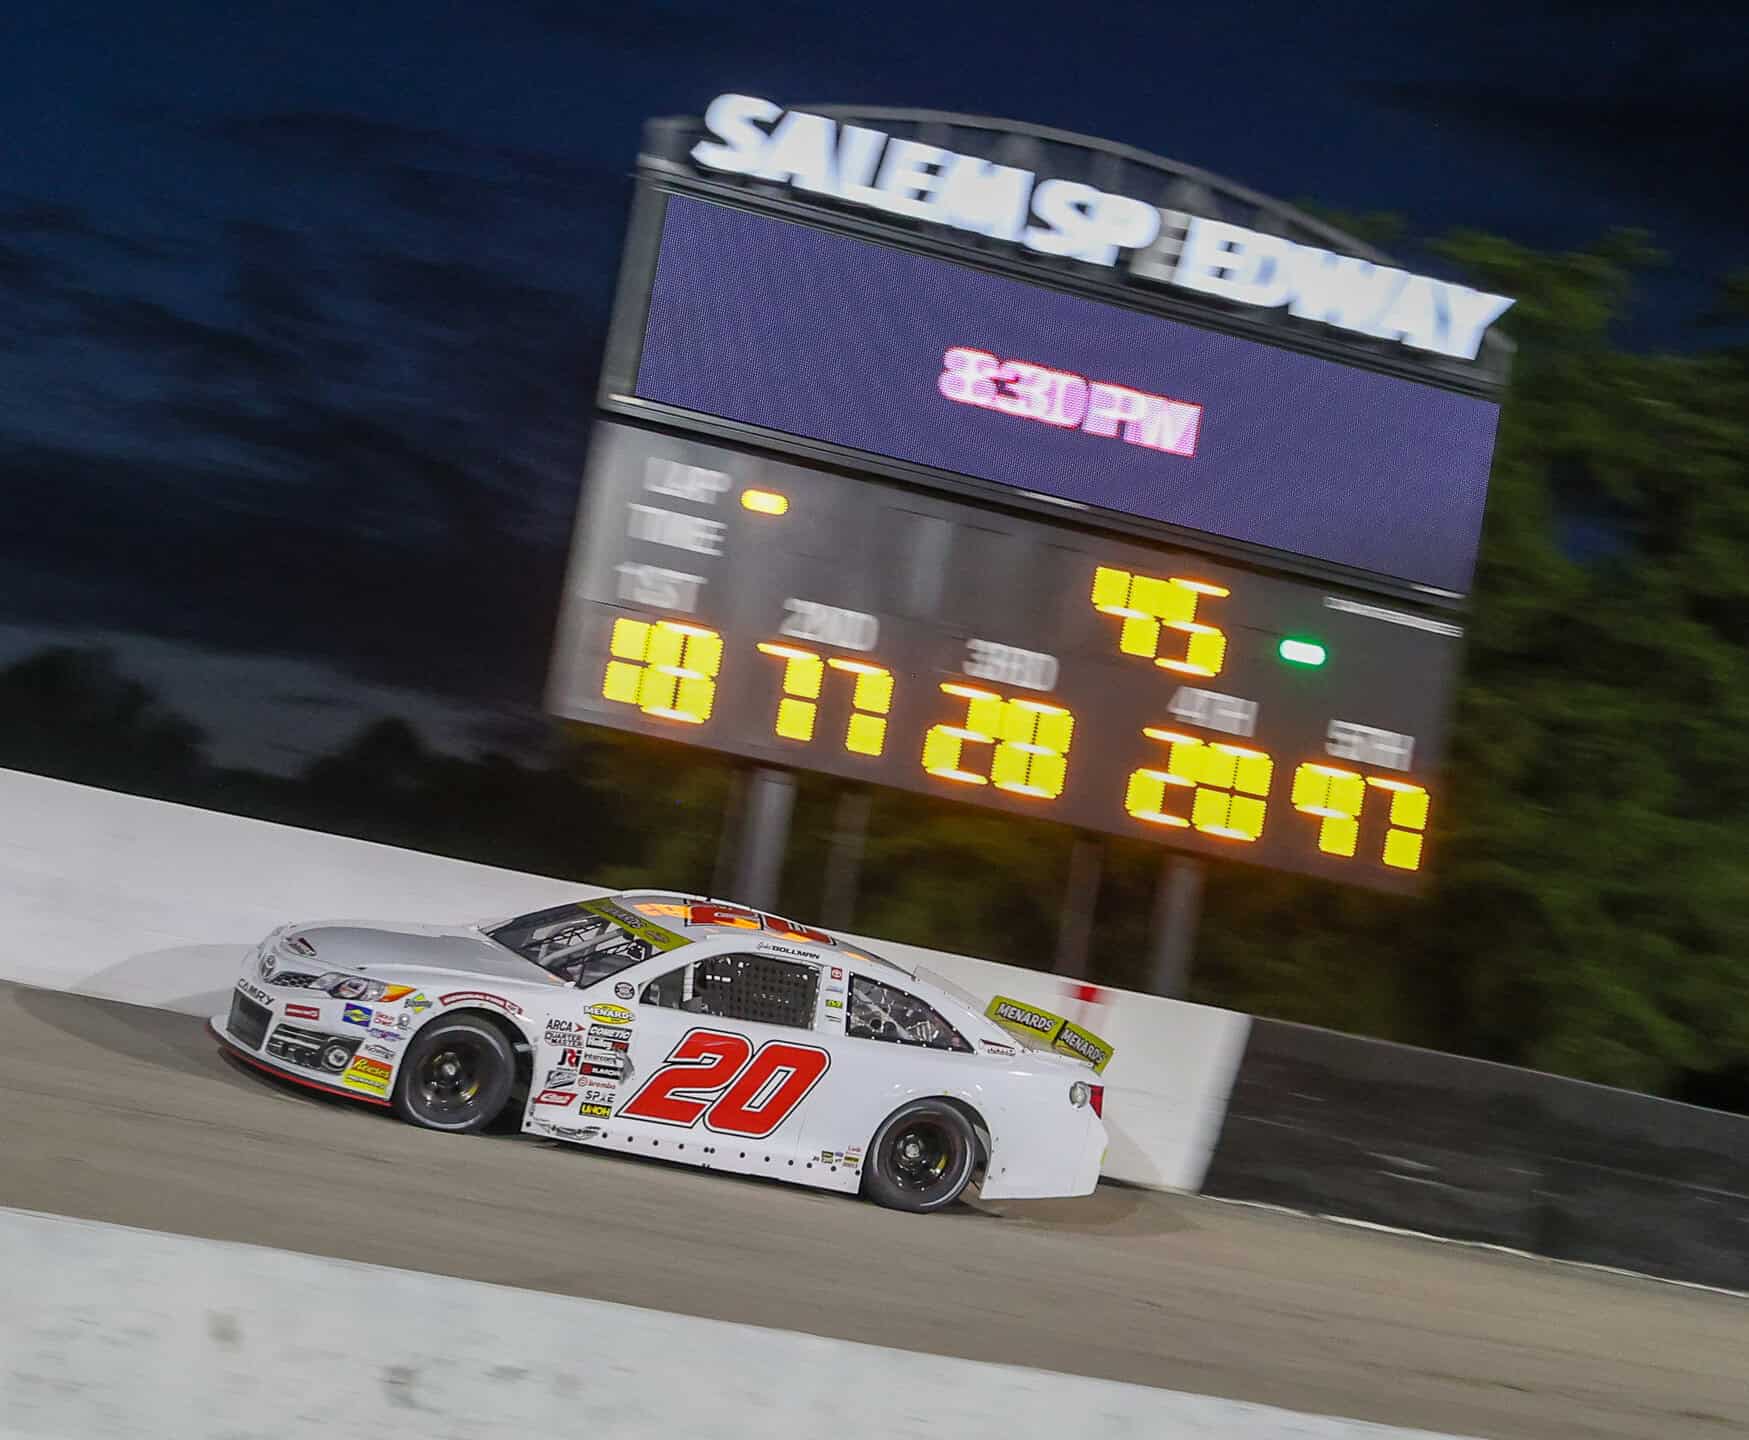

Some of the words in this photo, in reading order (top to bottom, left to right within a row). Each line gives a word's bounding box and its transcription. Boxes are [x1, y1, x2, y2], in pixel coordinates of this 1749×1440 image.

[690, 92, 1036, 243] SALEM
[1020, 178, 1517, 360] SPEEDWAY
[613, 561, 709, 614] 1ST
[778, 597, 881, 652] 2ND
[755, 641, 896, 758] 77
[1166, 685, 1259, 737] 4TH
[1290, 761, 1432, 872] 97
[237, 977, 276, 1006] CAMRY
[583, 1004, 637, 1021] MENARDS
[995, 1001, 1057, 1034] MENARDS
[546, 1018, 573, 1032] ARCA
[1060, 1027, 1106, 1065] MENARDS
[615, 1027, 832, 1139] 20
